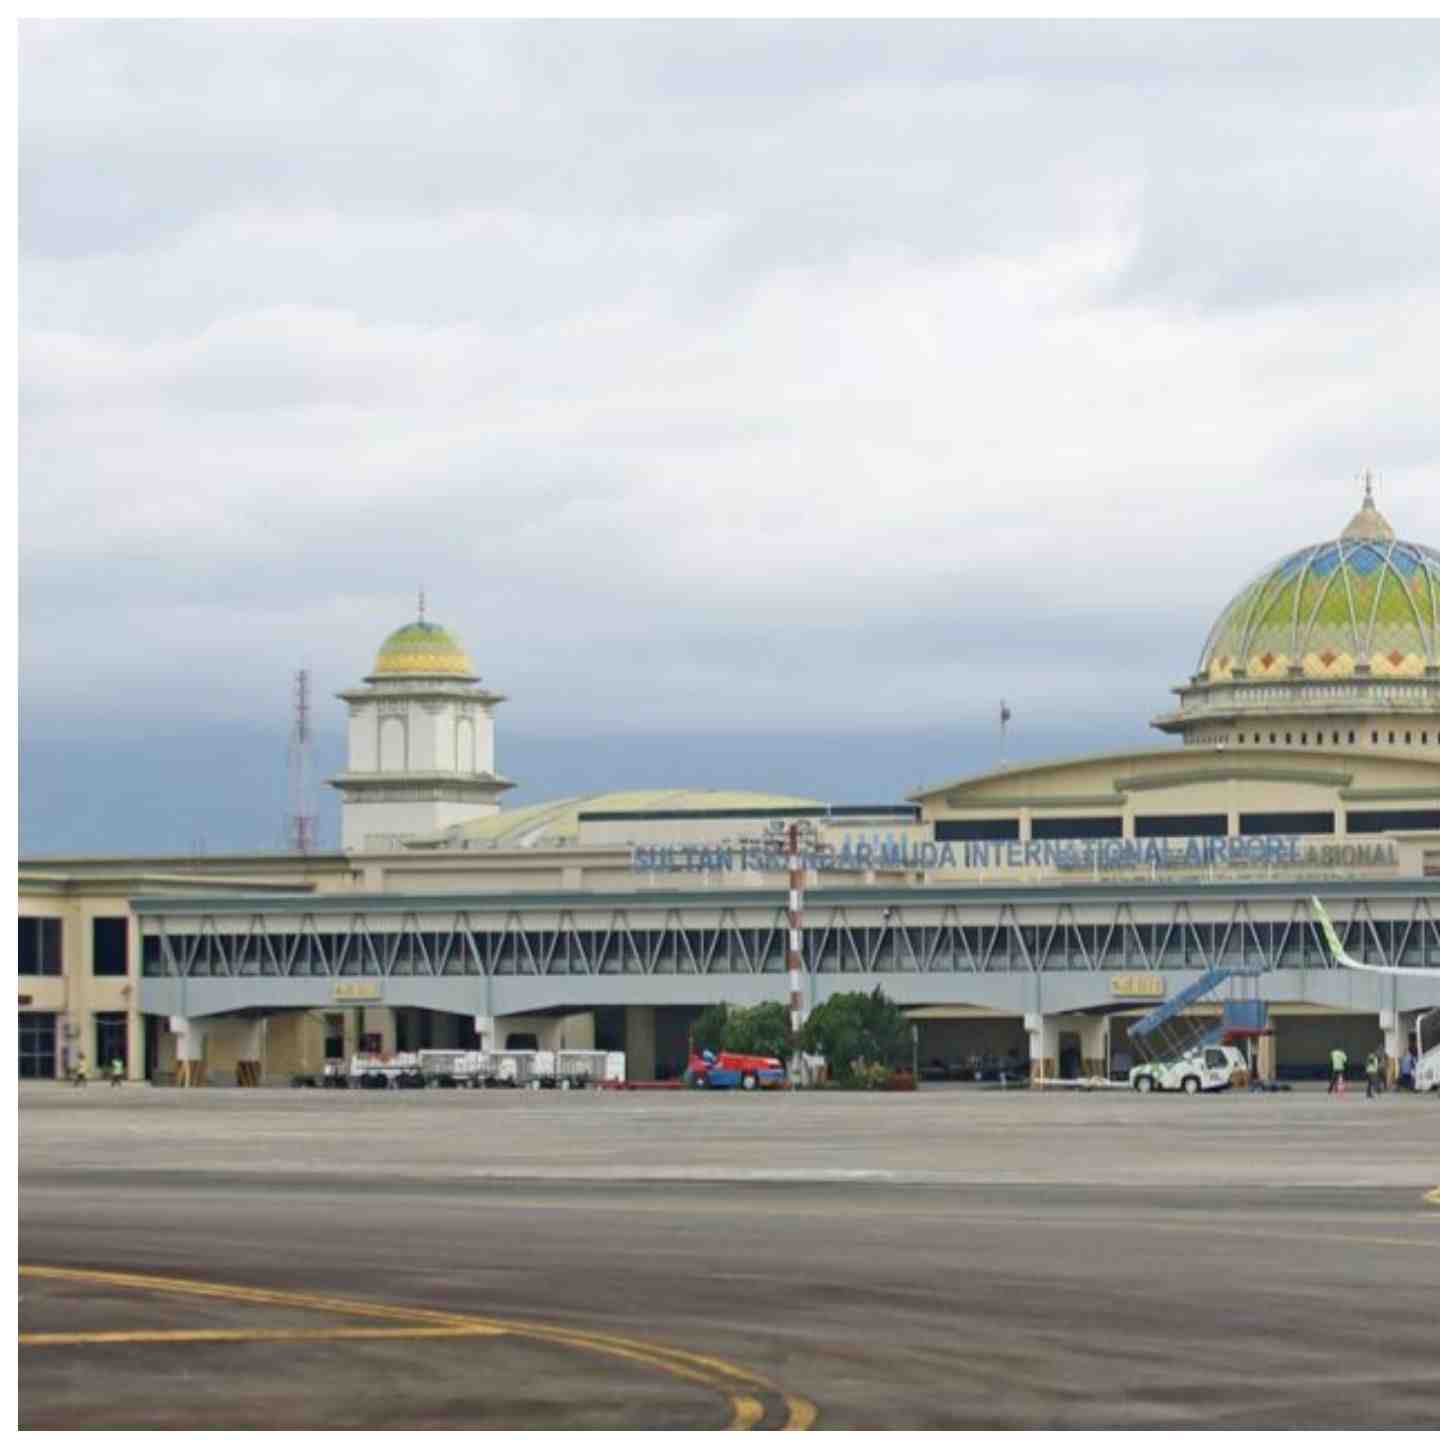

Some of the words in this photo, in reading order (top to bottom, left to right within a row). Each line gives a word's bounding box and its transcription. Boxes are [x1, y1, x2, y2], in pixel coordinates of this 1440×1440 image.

[881, 836, 957, 868] MUDA
[964, 837, 1168, 868] INTERNATIONAL
[1185, 835, 1301, 864] AIRPORT
